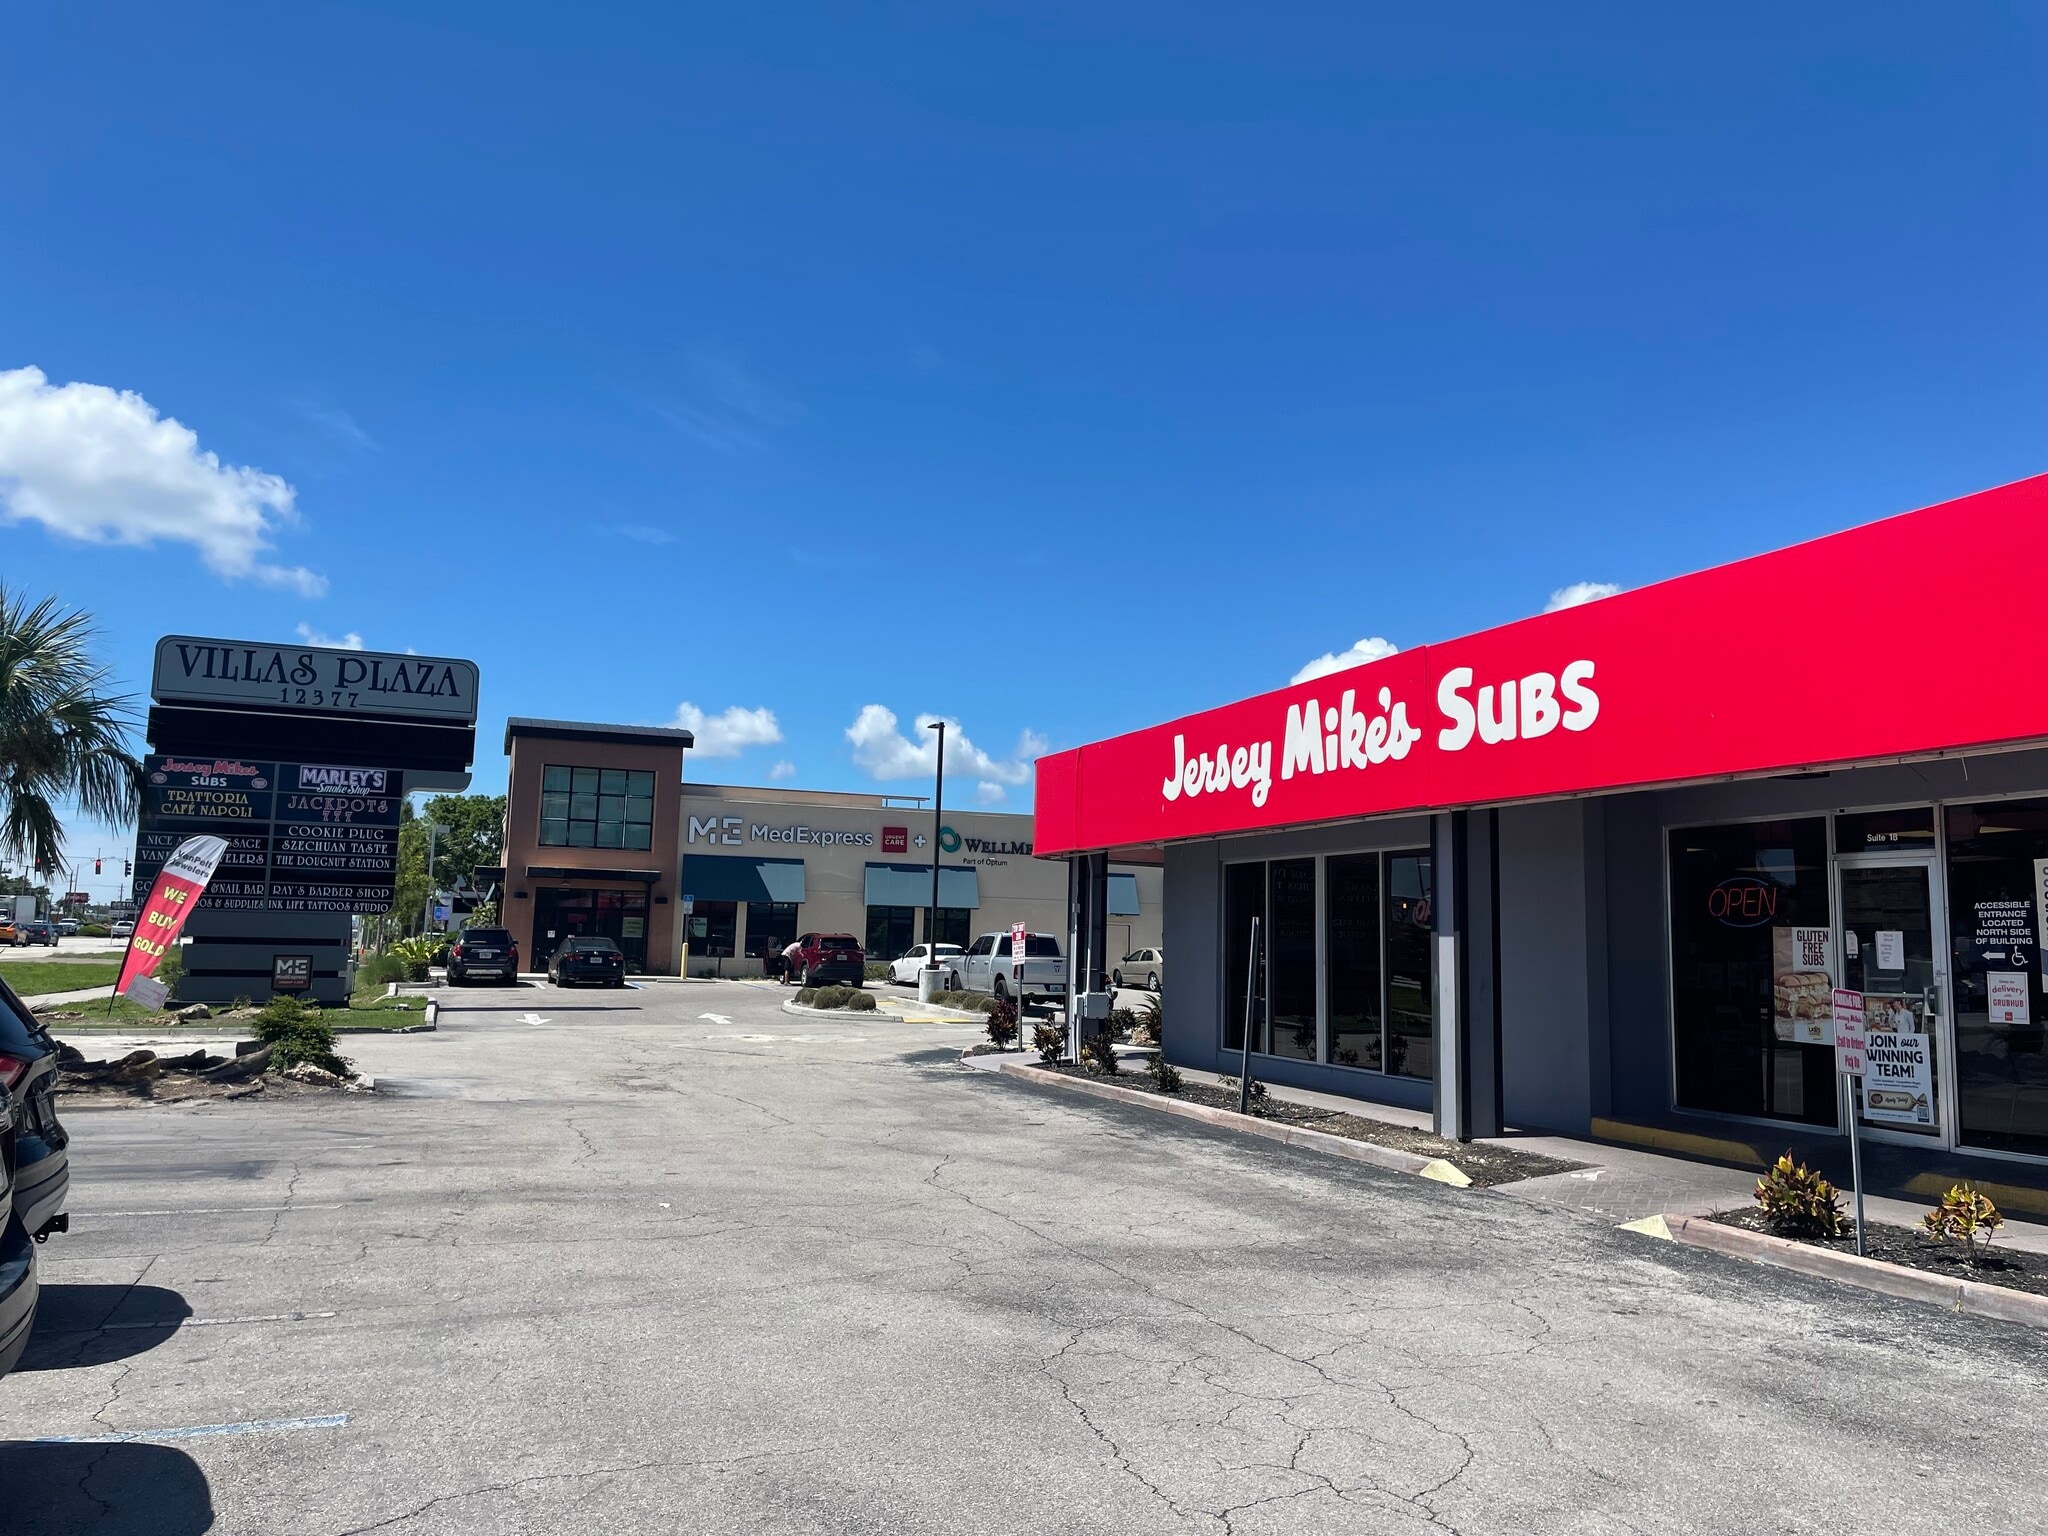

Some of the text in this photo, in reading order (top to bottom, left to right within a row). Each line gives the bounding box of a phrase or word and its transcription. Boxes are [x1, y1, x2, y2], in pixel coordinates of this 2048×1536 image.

[175, 644, 461, 697] VILLAS PLAZA
[280, 688, 360, 708] 12377
[1162, 734, 1273, 808] Jersey
[1281, 686, 1422, 780] Mike's
[160, 758, 211, 776] Jersey
[191, 776, 228, 787] SUBS
[302, 767, 384, 788] MARLEY'S
[317, 782, 371, 797] Smoke Shop
[167, 790, 248, 805] TRATTORIA
[287, 795, 389, 814] JACKPOTS
[161, 801, 253, 818] CAFÉ NAPOLI
[288, 825, 385, 840] COOKIE PLUG
[687, 816, 873, 847] ME MedExpress
[1866, 833, 1886, 842] Suite
[147, 835, 173, 846] NICE
[281, 840, 388, 855] SZECHUAN TASTE
[964, 838, 1033, 856] WELLME
[178, 850, 213, 869] VanPelt
[276, 855, 391, 870] THE DOUGNUT STATION
[962, 857, 1008, 867] Part of Optum
[170, 858, 210, 878] Jewelers
[163, 886, 189, 905] WE
[243, 885, 265, 895] BAR
[272, 885, 390, 899] RAY'S BARBER SHOP
[223, 898, 264, 909] SUPPLIES
[268, 899, 389, 913] INK LIFE TATTOOS STUDIO
[1708, 886, 1777, 917] OPEN
[1974, 900, 2031, 910] ACCESSIBLE
[148, 911, 179, 931] BUY
[1978, 910, 2027, 918] ENTRANCE
[1982, 919, 2024, 927] LOCATED
[1797, 930, 1829, 942] GLUTEN
[1976, 928, 2032, 936] NORTH SIDE
[133, 935, 166, 958] GOLD
[1803, 942, 1824, 954] FREE
[1975, 937, 2033, 945] OF BUILDING
[276, 959, 308, 975] ME
[1803, 954, 1825, 966] SUBS
[1992, 985, 2025, 996] delivery
[1993, 998, 2024, 1008] GRUBHUB
[1869, 1035, 1919, 1048] JOIN our
[1866, 1048, 1923, 1064] WINNING
[1876, 1063, 1915, 1078] TEAM!
